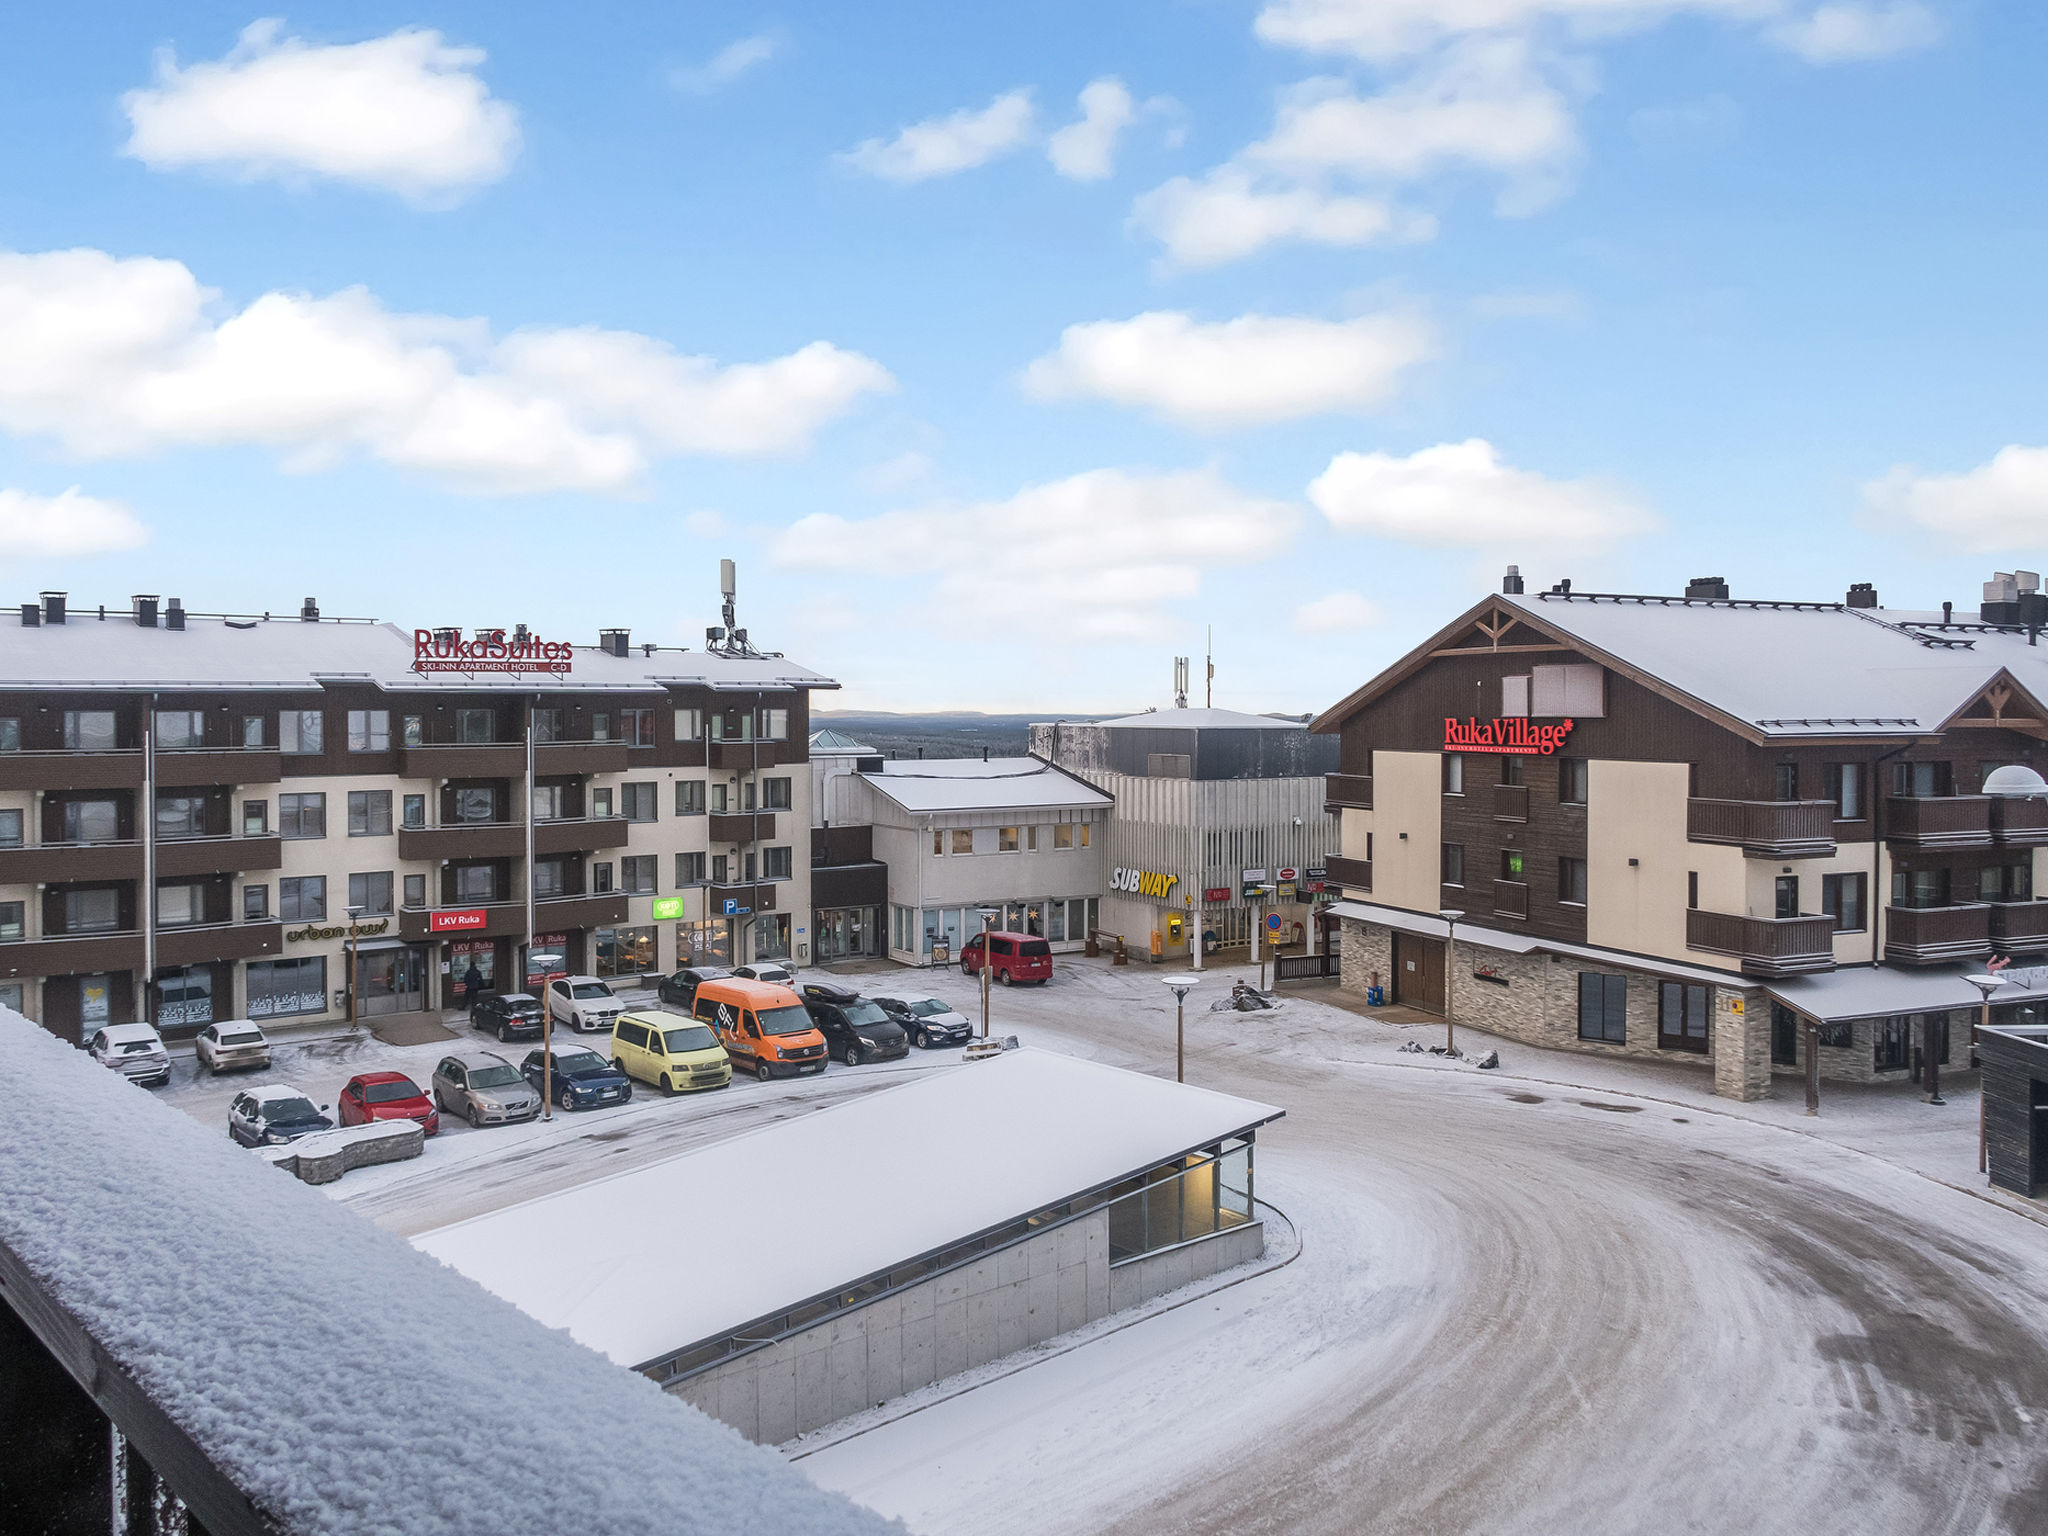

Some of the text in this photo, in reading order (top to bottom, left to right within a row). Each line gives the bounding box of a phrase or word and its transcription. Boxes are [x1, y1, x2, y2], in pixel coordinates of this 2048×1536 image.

[414, 629, 573, 659] RukaSuites
[421, 663, 456, 671] SKI-INN
[459, 663, 509, 671] APARTMENT
[511, 663, 539, 671] HOTEL
[1109, 867, 1177, 898] SUBWAY
[726, 901, 735, 914] P
[439, 916, 480, 926] LKV Ruka
[287, 924, 345, 942] urban
[548, 935, 567, 943] Ruka
[453, 942, 494, 952] LKV Ruka
